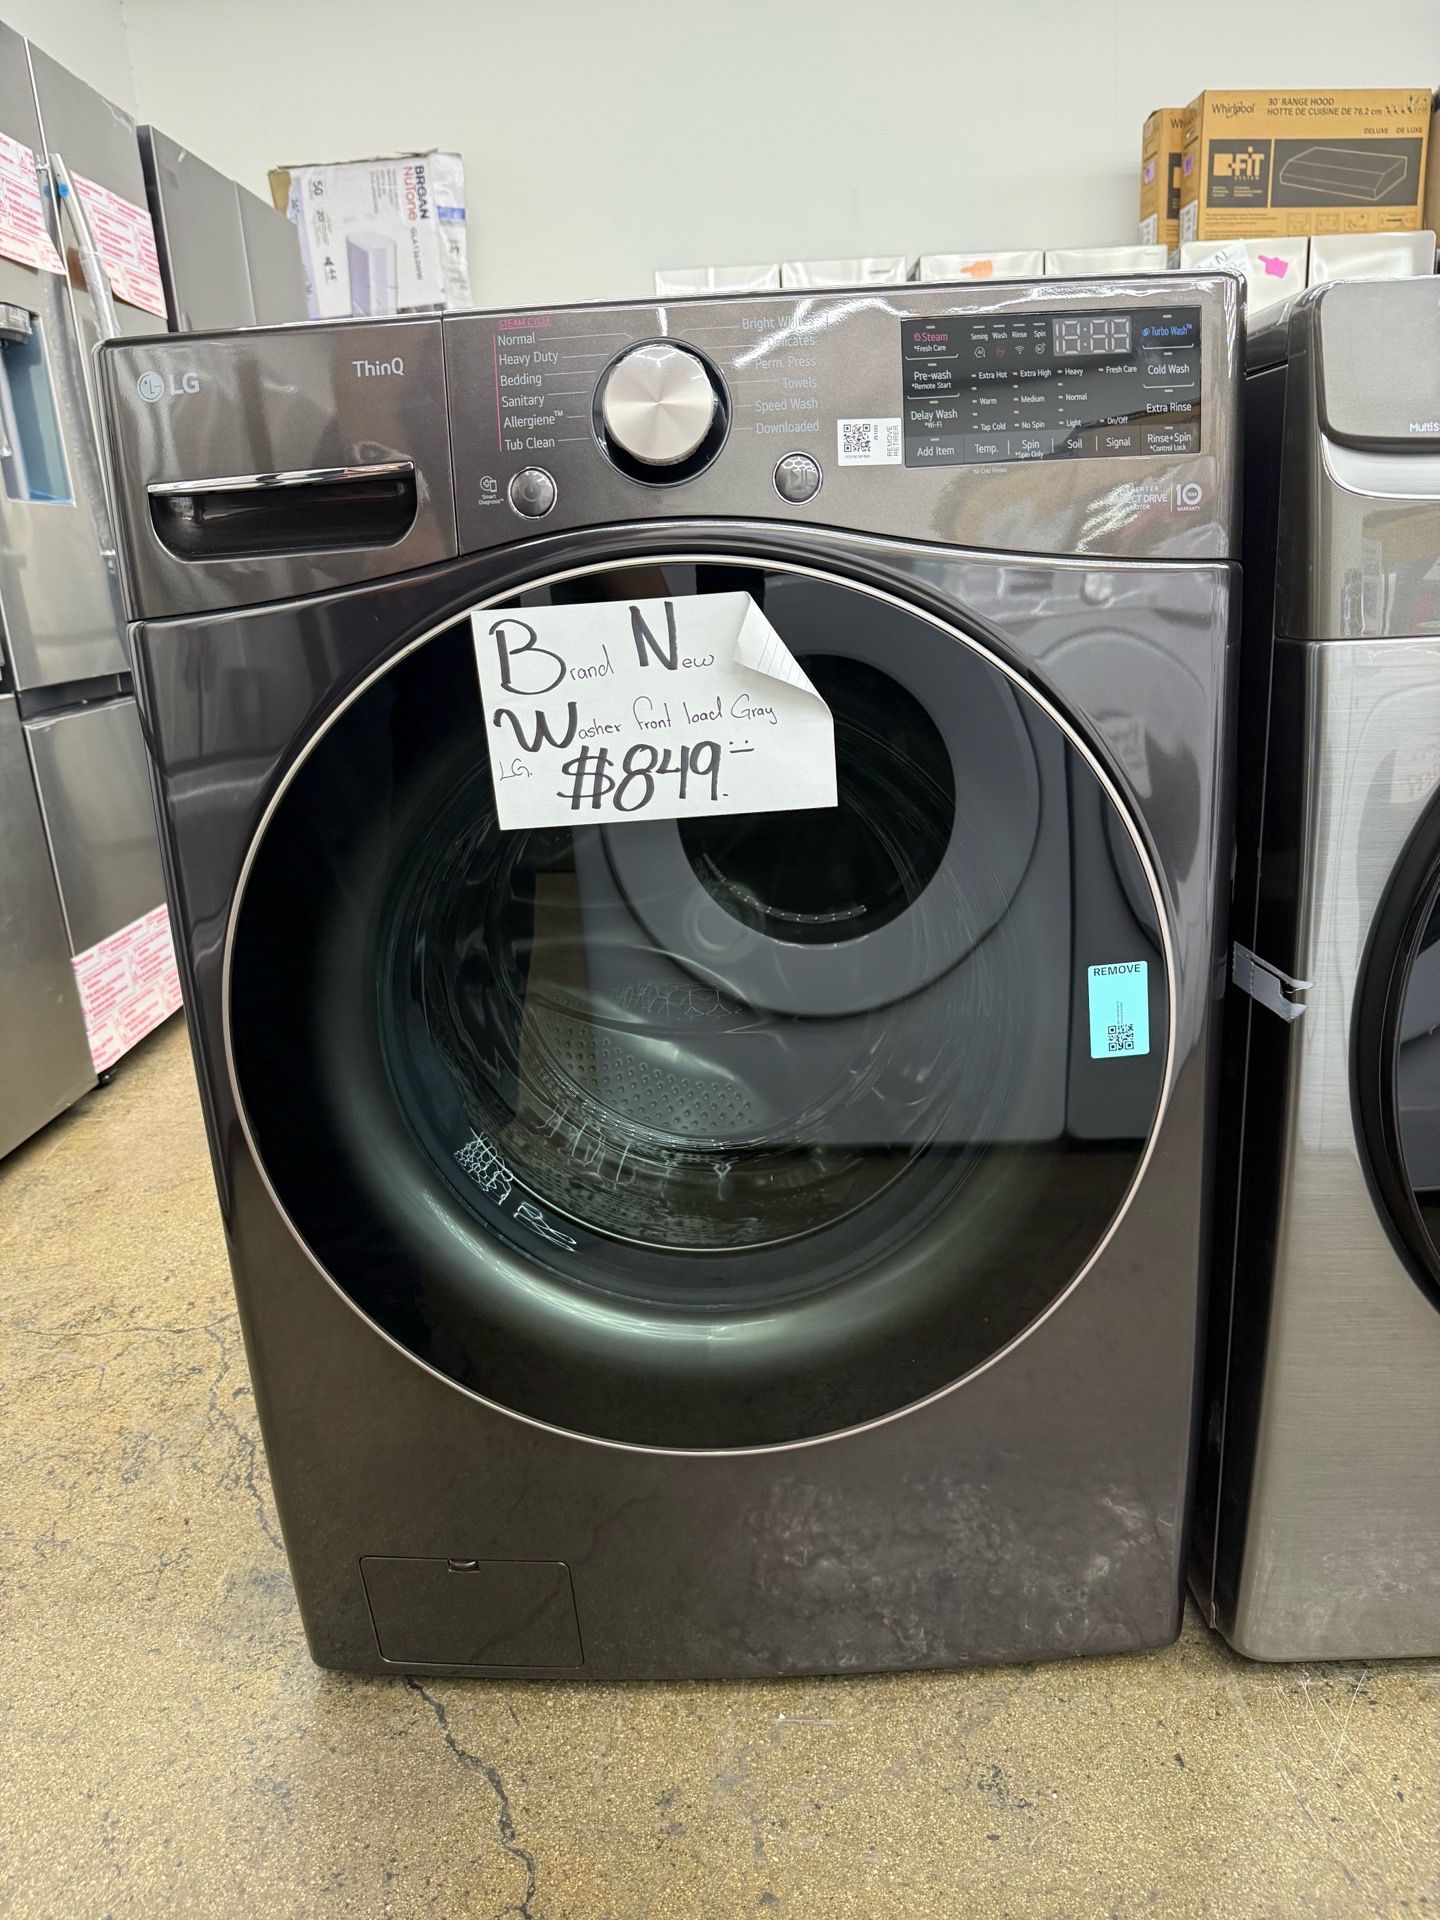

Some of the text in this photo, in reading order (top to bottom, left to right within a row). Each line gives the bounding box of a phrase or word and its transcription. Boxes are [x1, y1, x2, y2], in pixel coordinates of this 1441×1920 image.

[1310, 97, 1334, 105] HOOD
[1211, 101, 1256, 118] Whirlpool
[1267, 108, 1293, 116] HOTTE
[1308, 107, 1339, 116] CUISINE
[1341, 107, 1351, 115] DE
[742, 317, 775, 331] Bright
[922, 332, 948, 342] Steam
[1033, 330, 1047, 339] Spin
[1150, 326, 1169, 336] Turbo
[498, 331, 535, 346] Normal
[499, 351, 559, 366] Heavy Duty
[755, 356, 816, 370] Perm. Press
[352, 357, 404, 378] ThinQ
[1020, 369, 1052, 378] Extra High
[1065, 368, 1083, 376] Heavy
[1148, 363, 1190, 375] Cold Wash
[501, 374, 542, 387] Bedding
[913, 370, 952, 381] Pre-wash
[978, 371, 1008, 380] Extra Hot
[169, 372, 200, 396] LG
[783, 376, 817, 388] Towels
[502, 395, 545, 407] Sanitary
[1021, 396, 1045, 404] Medium
[1065, 393, 1087, 401] Normal
[755, 398, 818, 414] Speed Wash
[1146, 402, 1192, 413] Extra Rinse
[911, 408, 958, 422] Delay Wash
[1107, 416, 1128, 425] On/Off
[756, 420, 820, 434] Downloaded
[981, 422, 1006, 432] Tap Cold
[1021, 420, 1045, 429] No Spin
[1066, 419, 1081, 428] Light
[505, 437, 555, 450] Tub Clean
[1067, 439, 1083, 449] Soil
[1106, 436, 1131, 449] Signal
[1147, 432, 1192, 444] Rinse+Spin
[974, 443, 999, 455] Temp.
[1021, 439, 1040, 450] Spin
[917, 446, 955, 457] Add Item
[1030, 450, 1044, 458] Only
[1143, 493, 1168, 503] DRIVE
[1175, 483, 1202, 505] 10
[489, 601, 714, 695] Brand New
[493, 701, 622, 753] Washer
[683, 695, 723, 725] load
[730, 693, 778, 725] Gray
[1093, 963, 1141, 976] REMOVE
